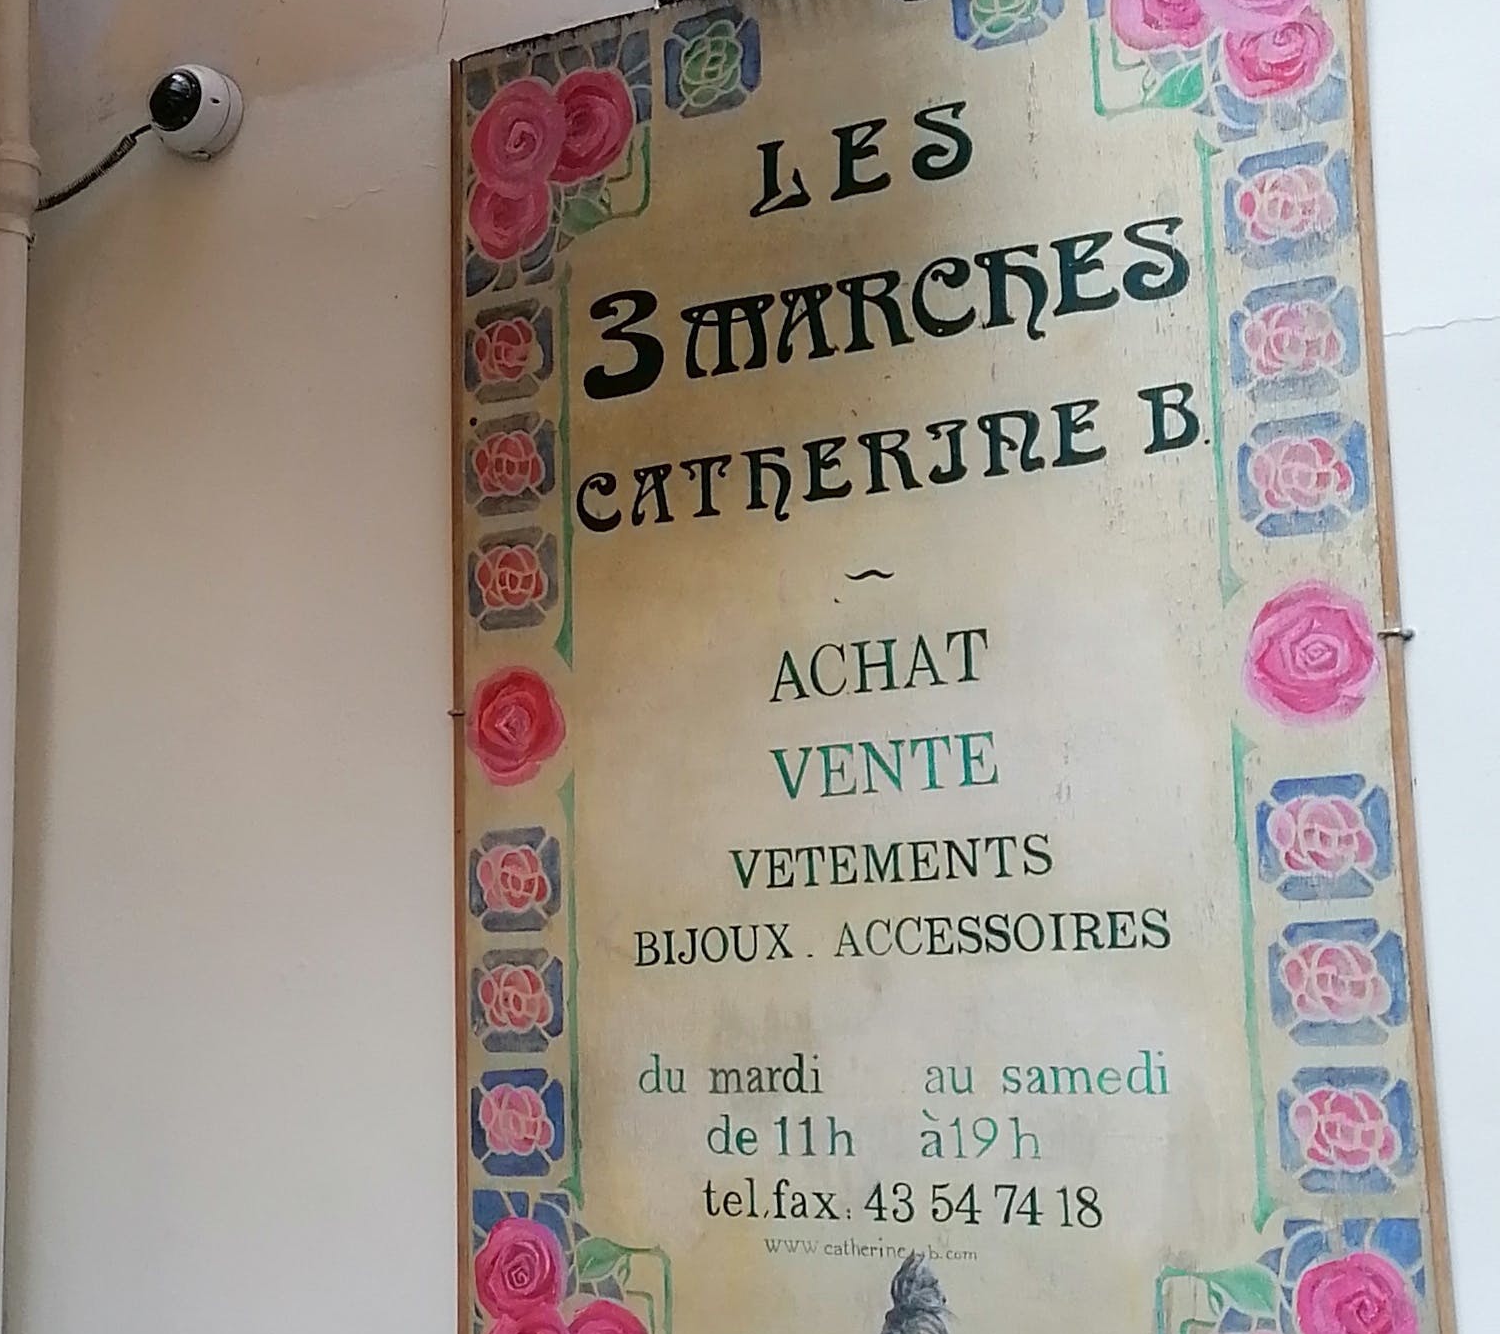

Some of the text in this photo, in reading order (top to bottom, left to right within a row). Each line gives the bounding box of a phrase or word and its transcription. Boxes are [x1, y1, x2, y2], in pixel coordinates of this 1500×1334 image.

[750, 101, 973, 218] LES
[584, 217, 1191, 399] 3 MARCHES
[576, 398, 1107, 533] CATHERINE
[769, 628, 988, 702] ACHAT
[769, 731, 999, 799] VENTE
[729, 834, 1053, 889] VETEMENTS
[633, 923, 794, 966] BIJOUX
[833, 908, 1171, 958] ACCESSOIRES
[639, 1050, 1169, 1095] du mardi au samedi
[707, 1114, 758, 1156] de
[864, 1182, 914, 1223] 43
[932, 1183, 982, 1226] 54
[994, 1184, 1044, 1227] 74
[1058, 1186, 1103, 1228] 18
